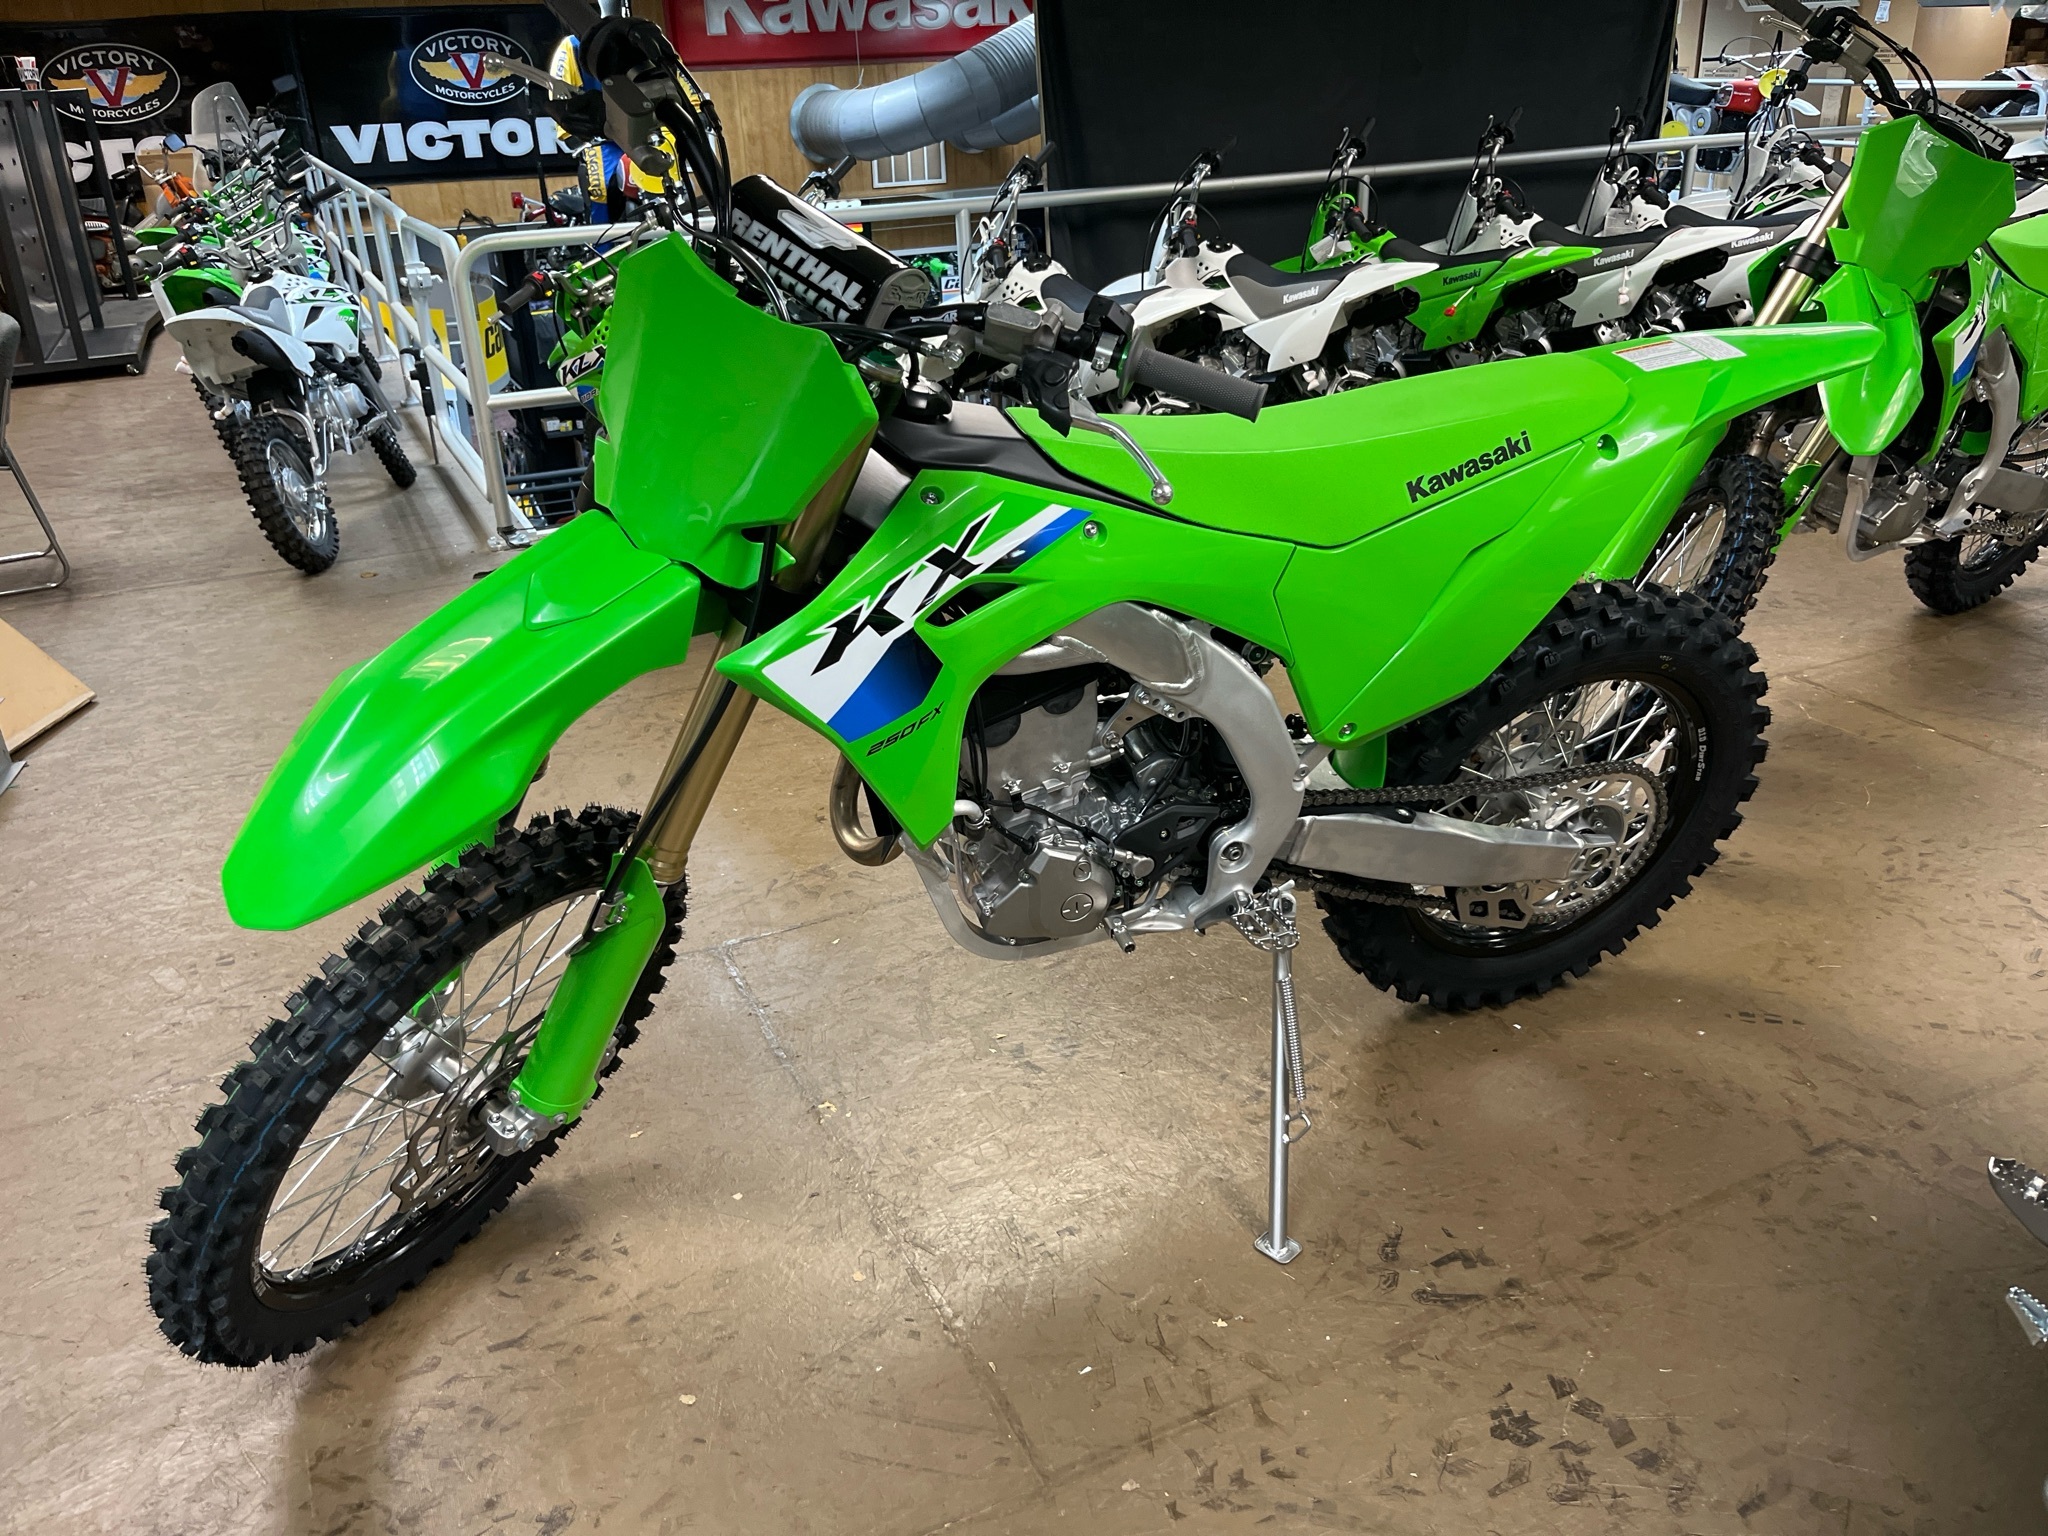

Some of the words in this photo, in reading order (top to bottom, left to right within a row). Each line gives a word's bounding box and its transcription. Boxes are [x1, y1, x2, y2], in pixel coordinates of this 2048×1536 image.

[425, 35, 513, 58] VICTORY
[56, 50, 156, 76] VICTORY
[435, 81, 516, 100] MOTORCYCLES
[329, 116, 576, 164] VICTOR
[1730, 231, 1775, 249] Kawasaki
[731, 207, 863, 311] RENTHAL
[1593, 248, 1635, 267] Kawasaki
[1442, 268, 1482, 286] Kawasaki
[1282, 285, 1320, 305] Kawasaki
[1405, 430, 1532, 504] Kawasaki
[810, 511, 993, 676] KX
[865, 701, 945, 757] 250FX
